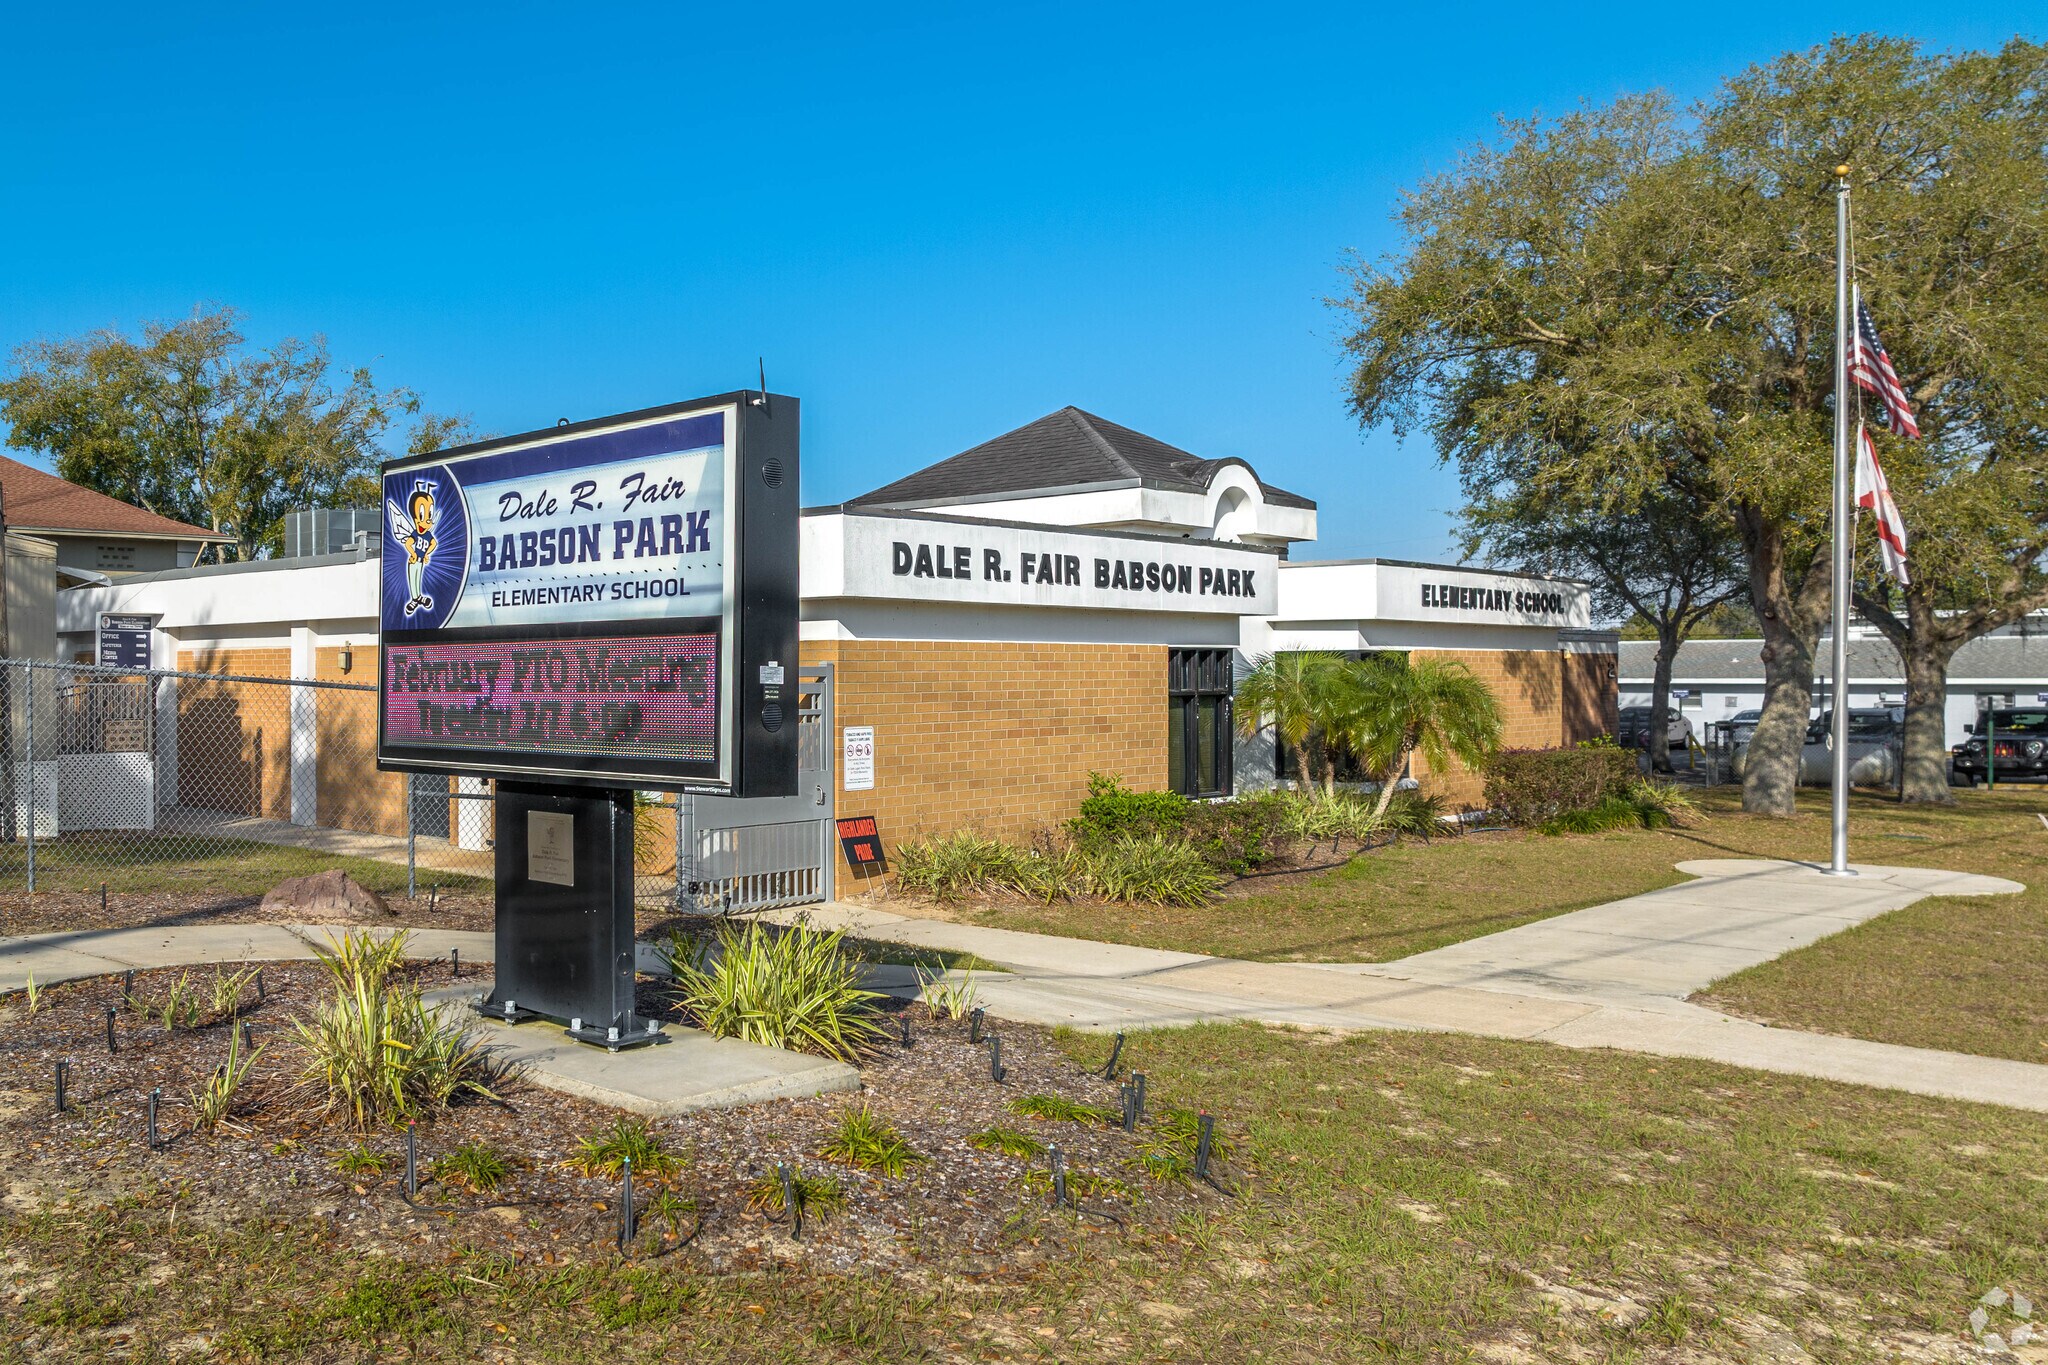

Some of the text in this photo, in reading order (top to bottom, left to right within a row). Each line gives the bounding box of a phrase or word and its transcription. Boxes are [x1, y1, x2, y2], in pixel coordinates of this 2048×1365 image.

[498, 472, 686, 523] Dale R. Fair
[416, 535, 430, 552] BP
[478, 510, 711, 572] BABSON PARK
[892, 541, 1256, 598] DALE R. FAIR BABSON PARK
[492, 577, 691, 608] ELEMENTARY SCHOOL
[1421, 583, 1565, 614] ELEMENTARY SCHOOL
[511, 649, 568, 692] PTO
[575, 647, 710, 708] Meeting
[1607, 661, 1615, 678] 2
[837, 819, 877, 838] HIGHLANDER
